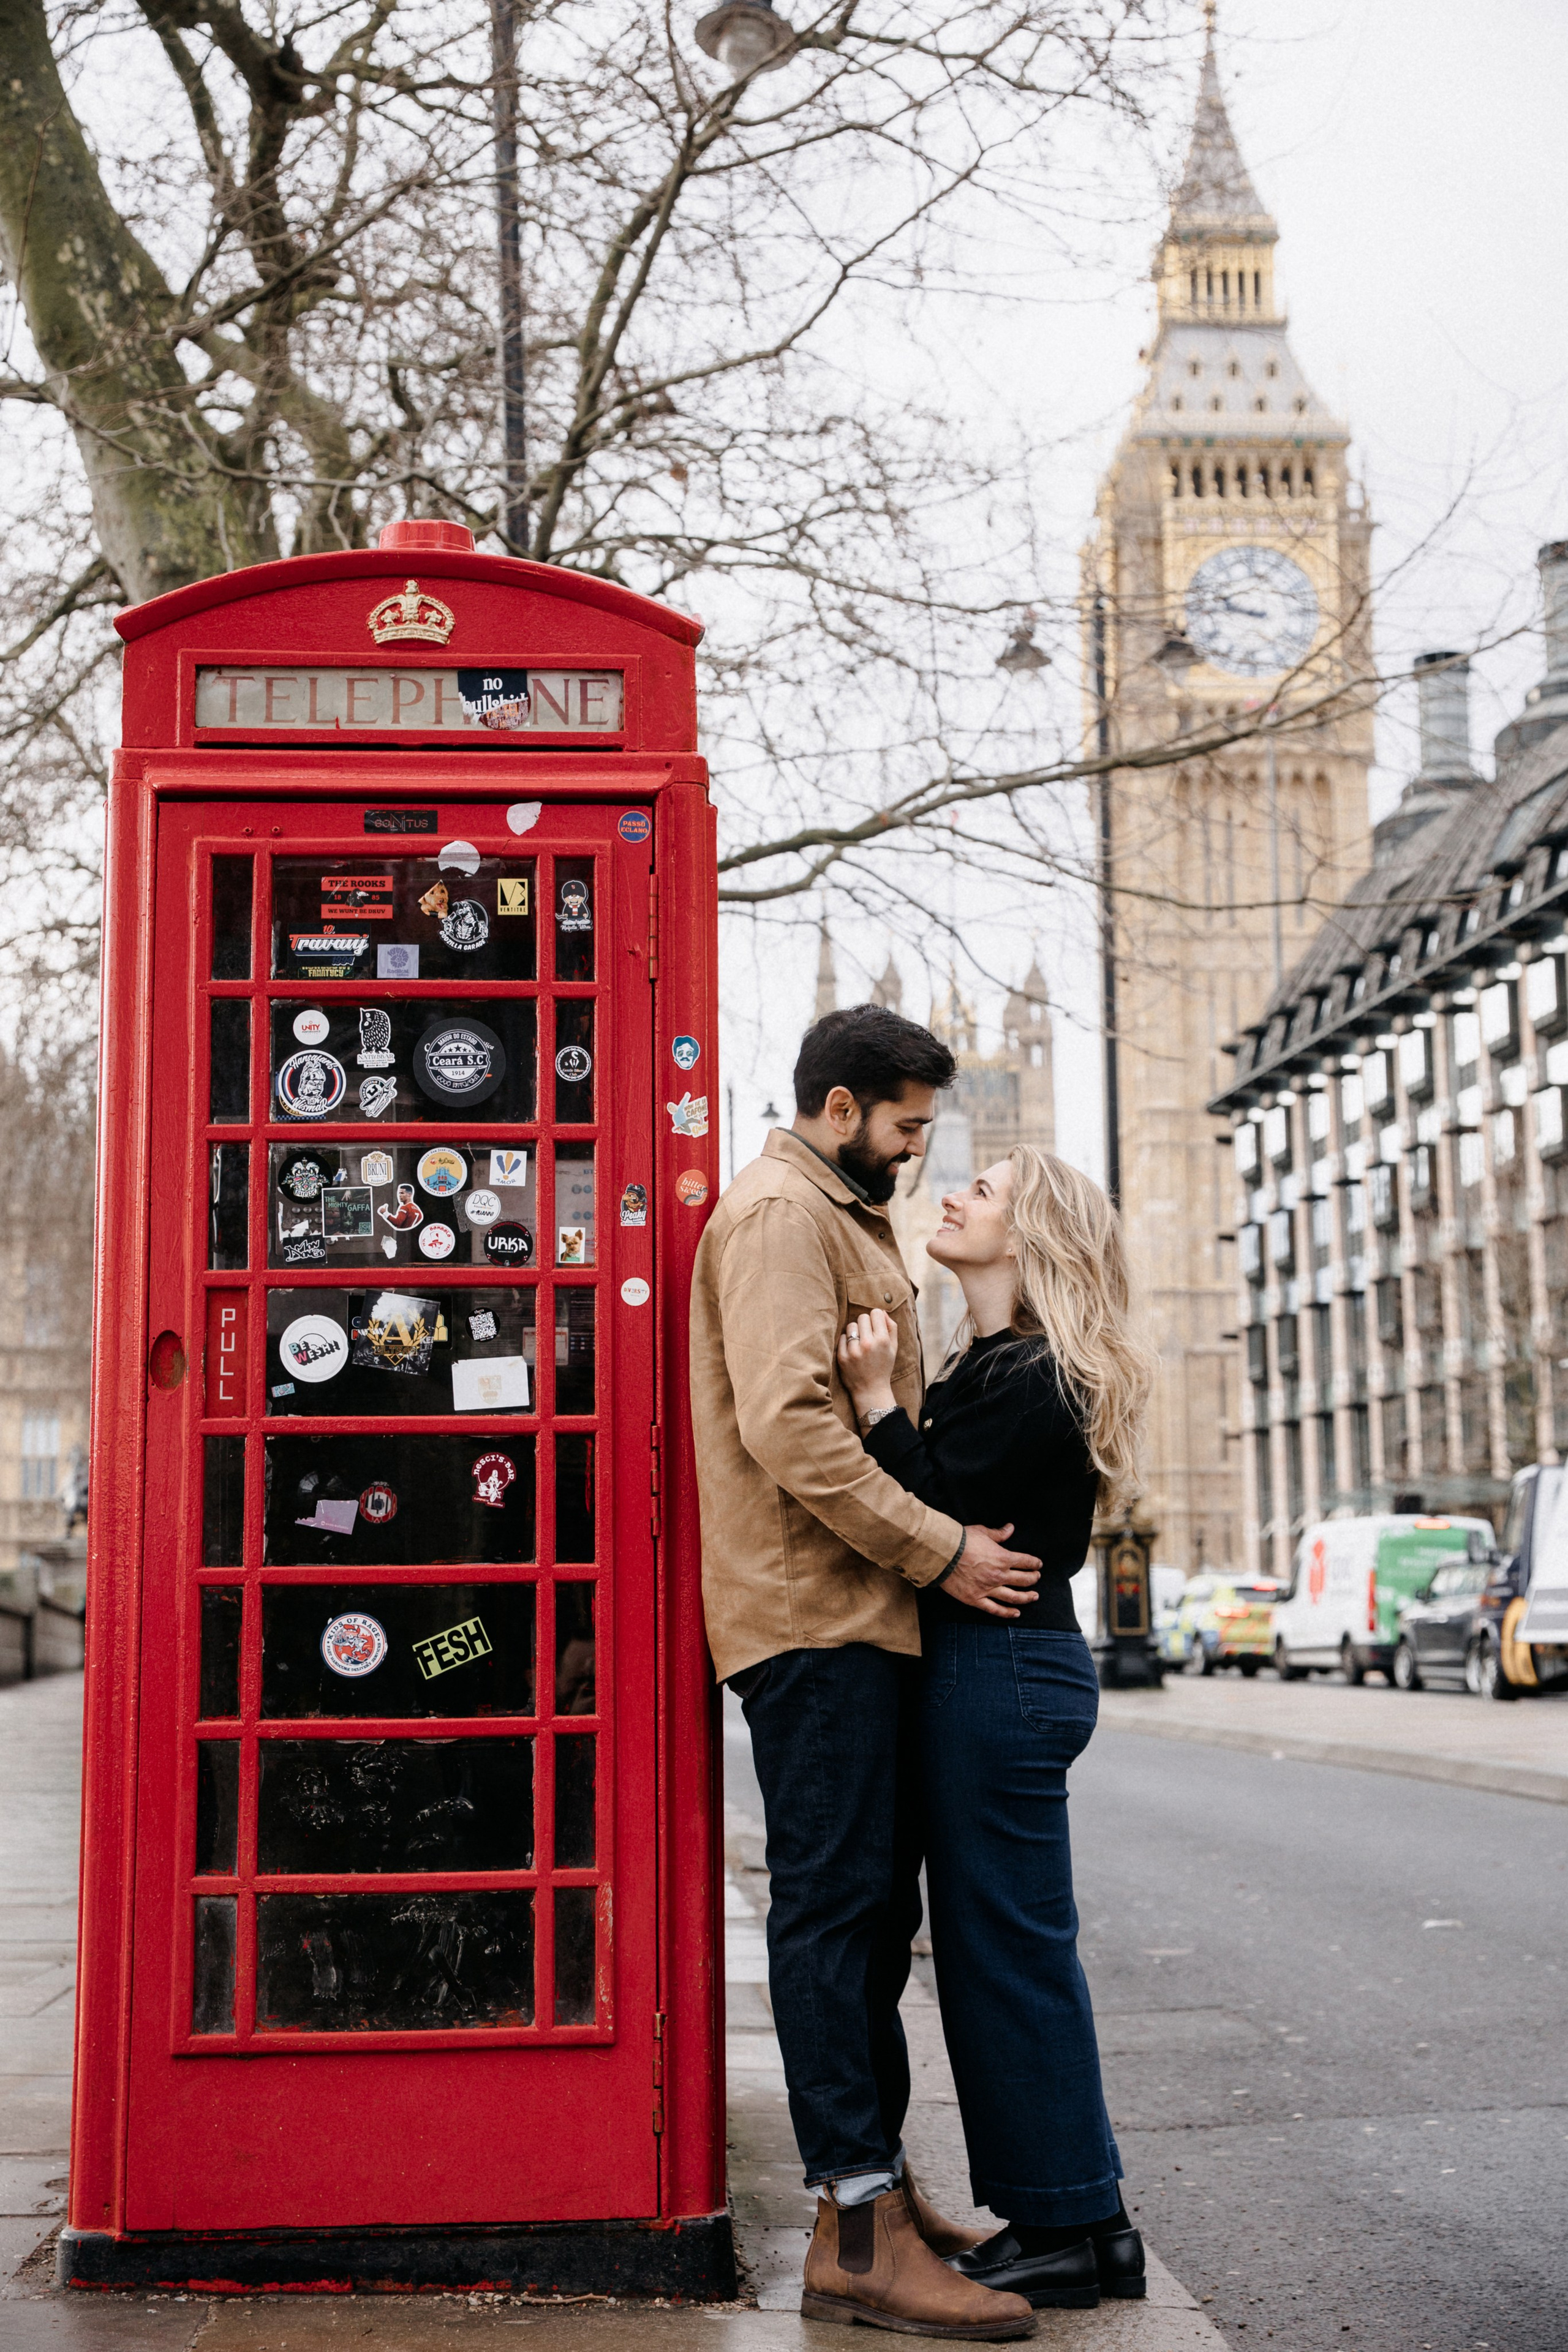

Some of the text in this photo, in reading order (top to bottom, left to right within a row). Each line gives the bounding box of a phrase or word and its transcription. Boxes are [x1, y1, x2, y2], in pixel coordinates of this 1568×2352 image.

[483, 677, 503, 690] no
[214, 676, 610, 725] TELEPHNE
[439, 930, 486, 950] GODZILLA GARAGE
[331, 956, 355, 966] 1994
[437, 1034, 453, 1046] MAIOR
[461, 1033, 478, 1045] ESTADO
[432, 1055, 484, 1066] Ceará S.C
[368, 1163, 387, 1175] BRUNI
[682, 1177, 706, 1190] bitter
[472, 1194, 496, 1207] DQC
[412, 1212, 420, 1227] 7
[622, 1208, 647, 1221] Peaky
[488, 1236, 528, 1253] URKA
[219, 1308, 236, 1400] PULL
[328, 1621, 343, 1640] KIDS
[362, 1619, 380, 1638] RAGE
[415, 1620, 490, 1677] FESH
[331, 1656, 350, 1672] HARDCORE
[351, 1662, 372, 1672] DELIVERY
[371, 1642, 381, 1662] SERVICES
